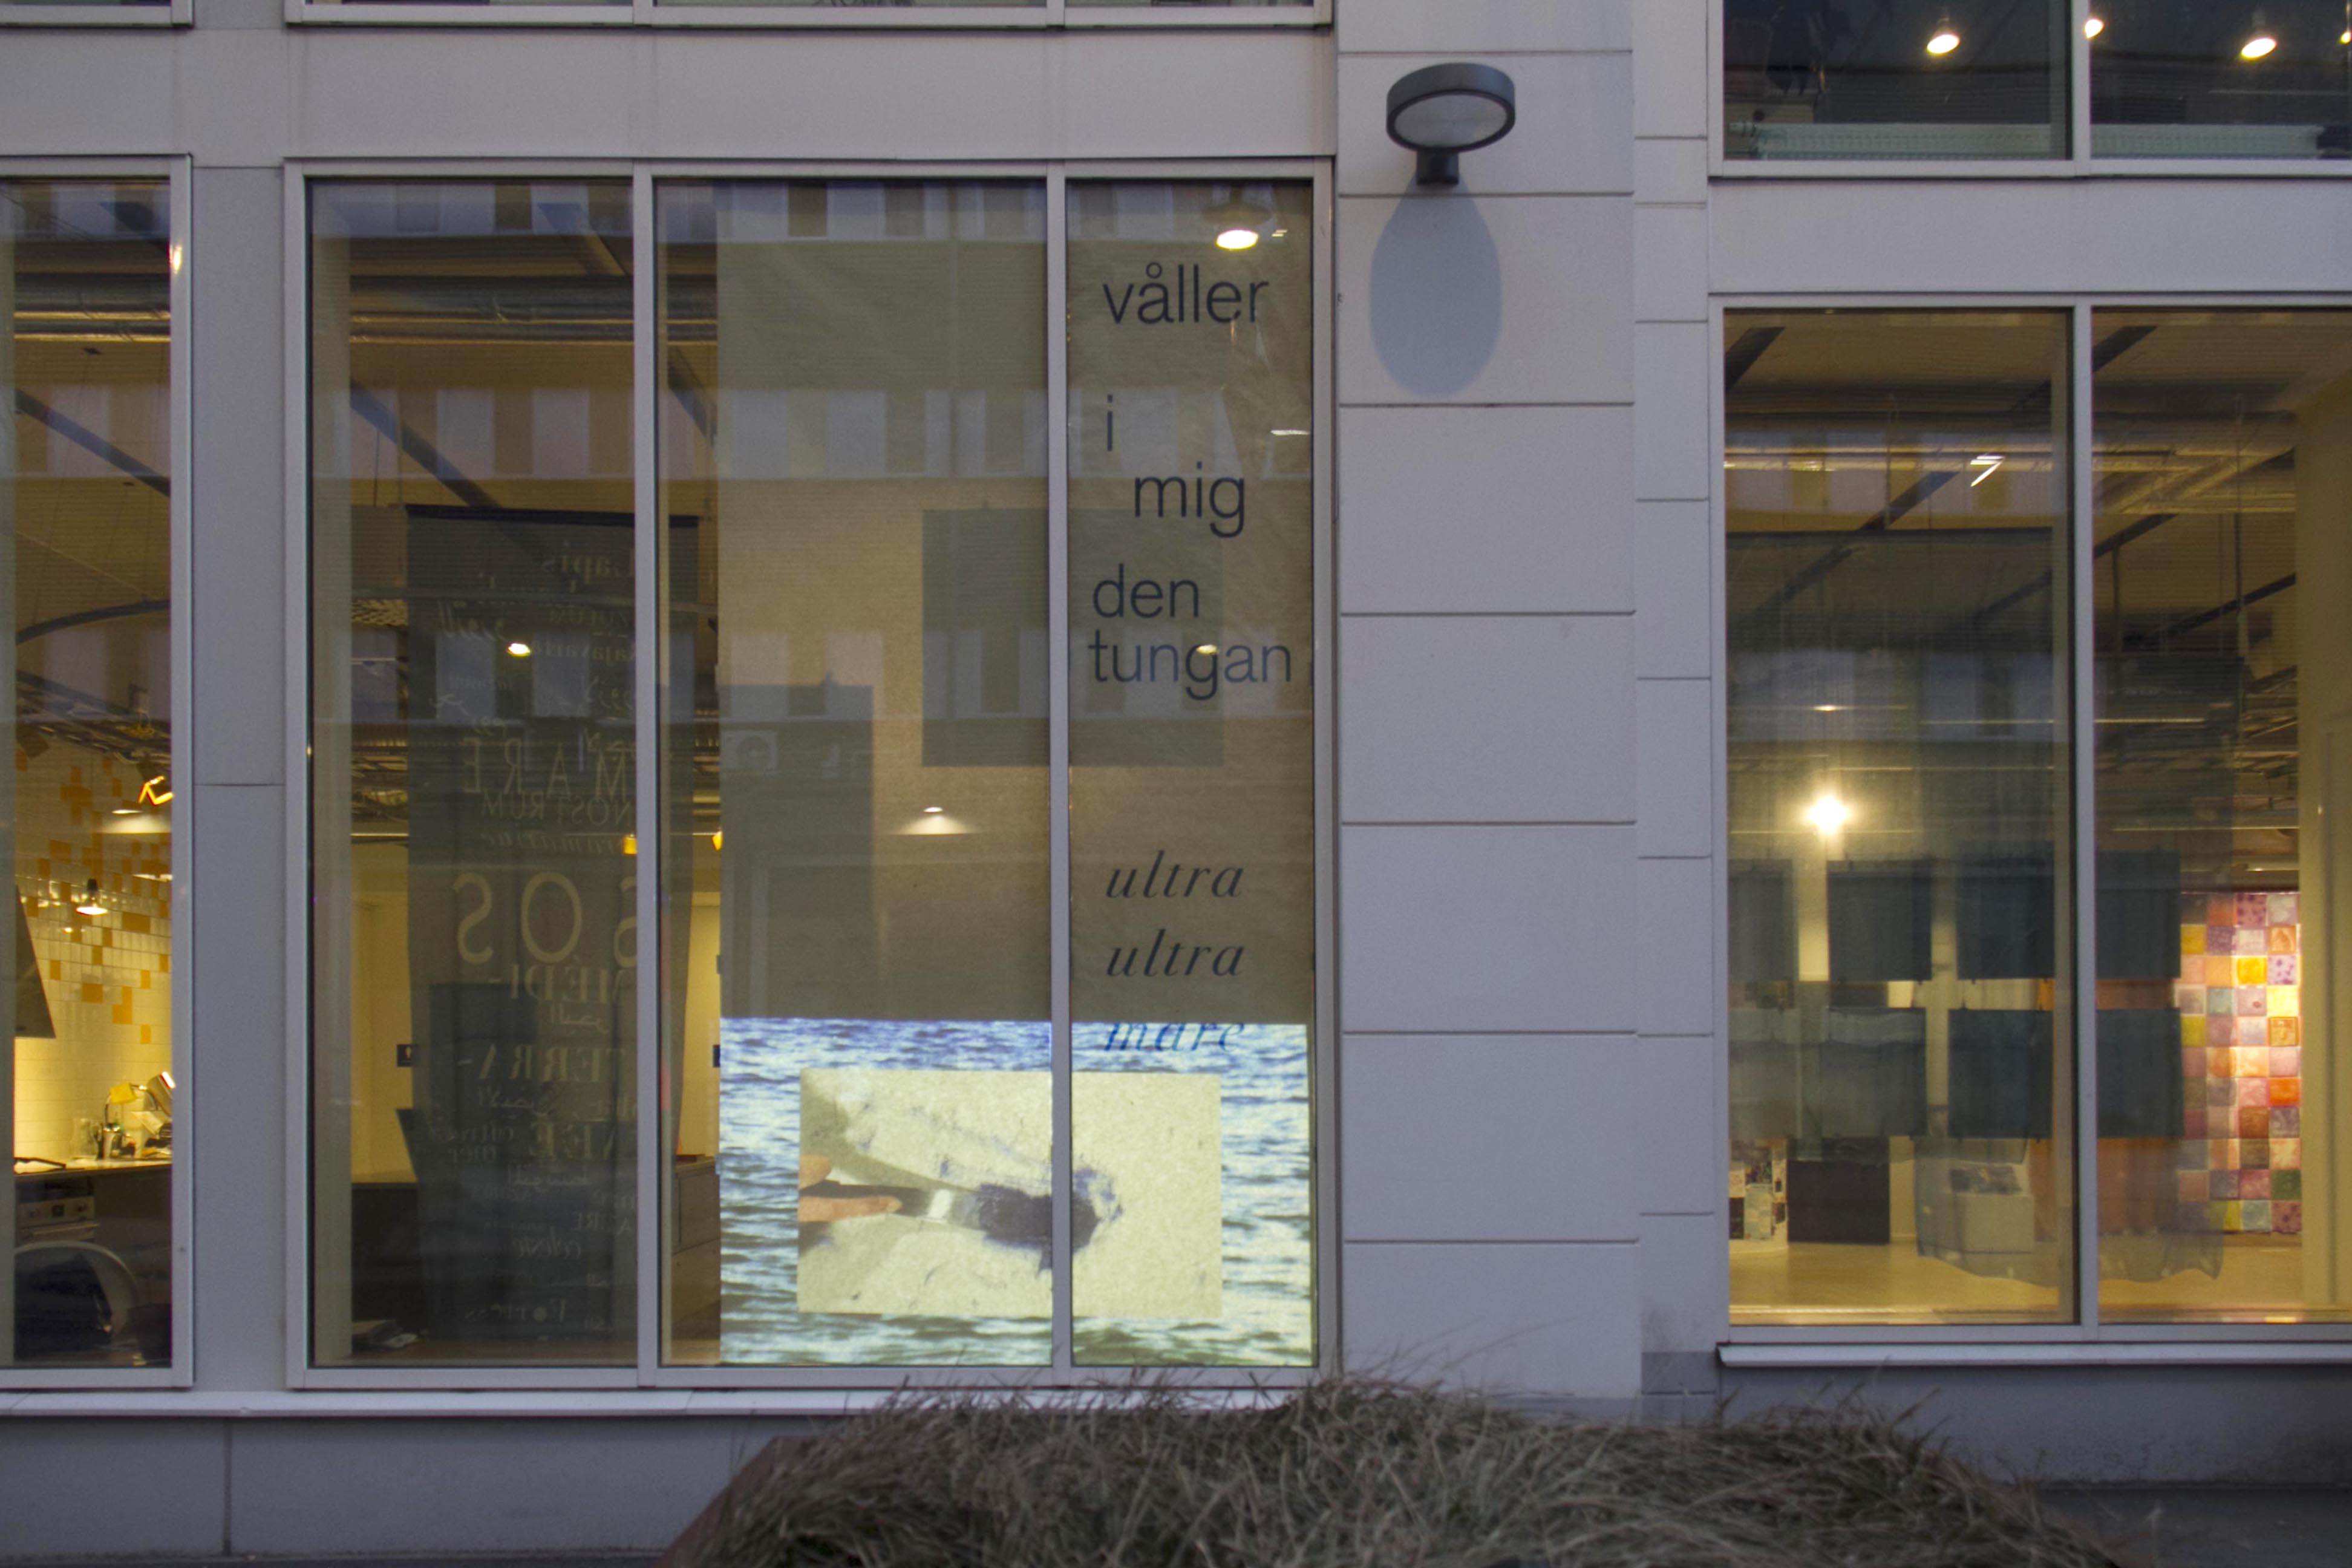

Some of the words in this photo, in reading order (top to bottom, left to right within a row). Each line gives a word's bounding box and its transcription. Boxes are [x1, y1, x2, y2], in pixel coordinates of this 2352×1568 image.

[1103, 262, 1269, 325] våller
[1106, 394, 1114, 451] i
[1134, 462, 1245, 538] mig
[1092, 563, 1199, 618] den
[1088, 629, 1292, 701] tungan
[1105, 850, 1244, 899] ultra
[1106, 928, 1246, 978] ultra
[1103, 1022, 1245, 1053] mare
